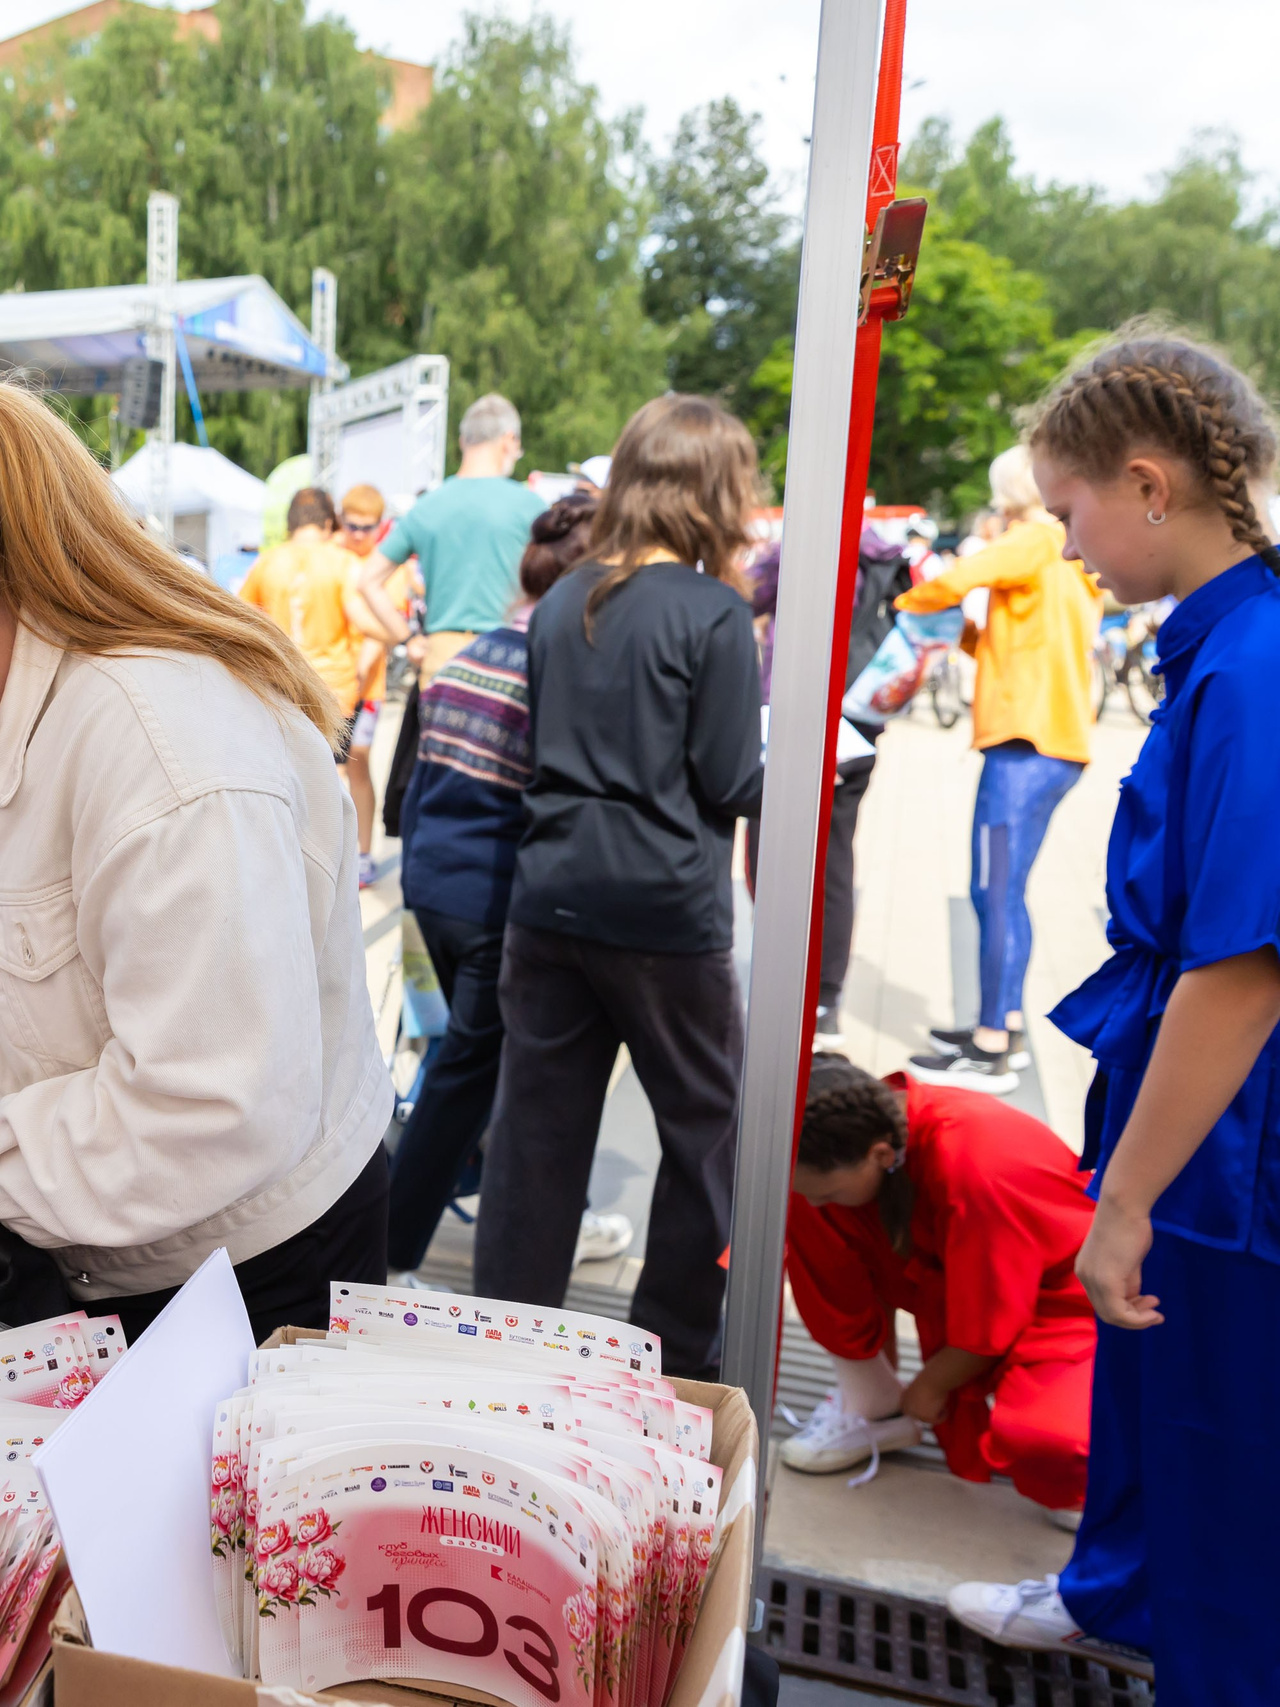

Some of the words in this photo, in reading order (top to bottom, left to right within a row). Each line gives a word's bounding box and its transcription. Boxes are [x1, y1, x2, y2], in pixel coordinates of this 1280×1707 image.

[486, 1329, 502, 1337] ПАПА
[463, 1485, 480, 1494] ПАПА
[420, 1505, 520, 1558] ЖЕНСКИЙ
[378, 1542, 408, 1550] клуб
[446, 1538, 498, 1554] забег
[385, 1550, 439, 1558] беговых
[367, 1584, 560, 1702] 103
